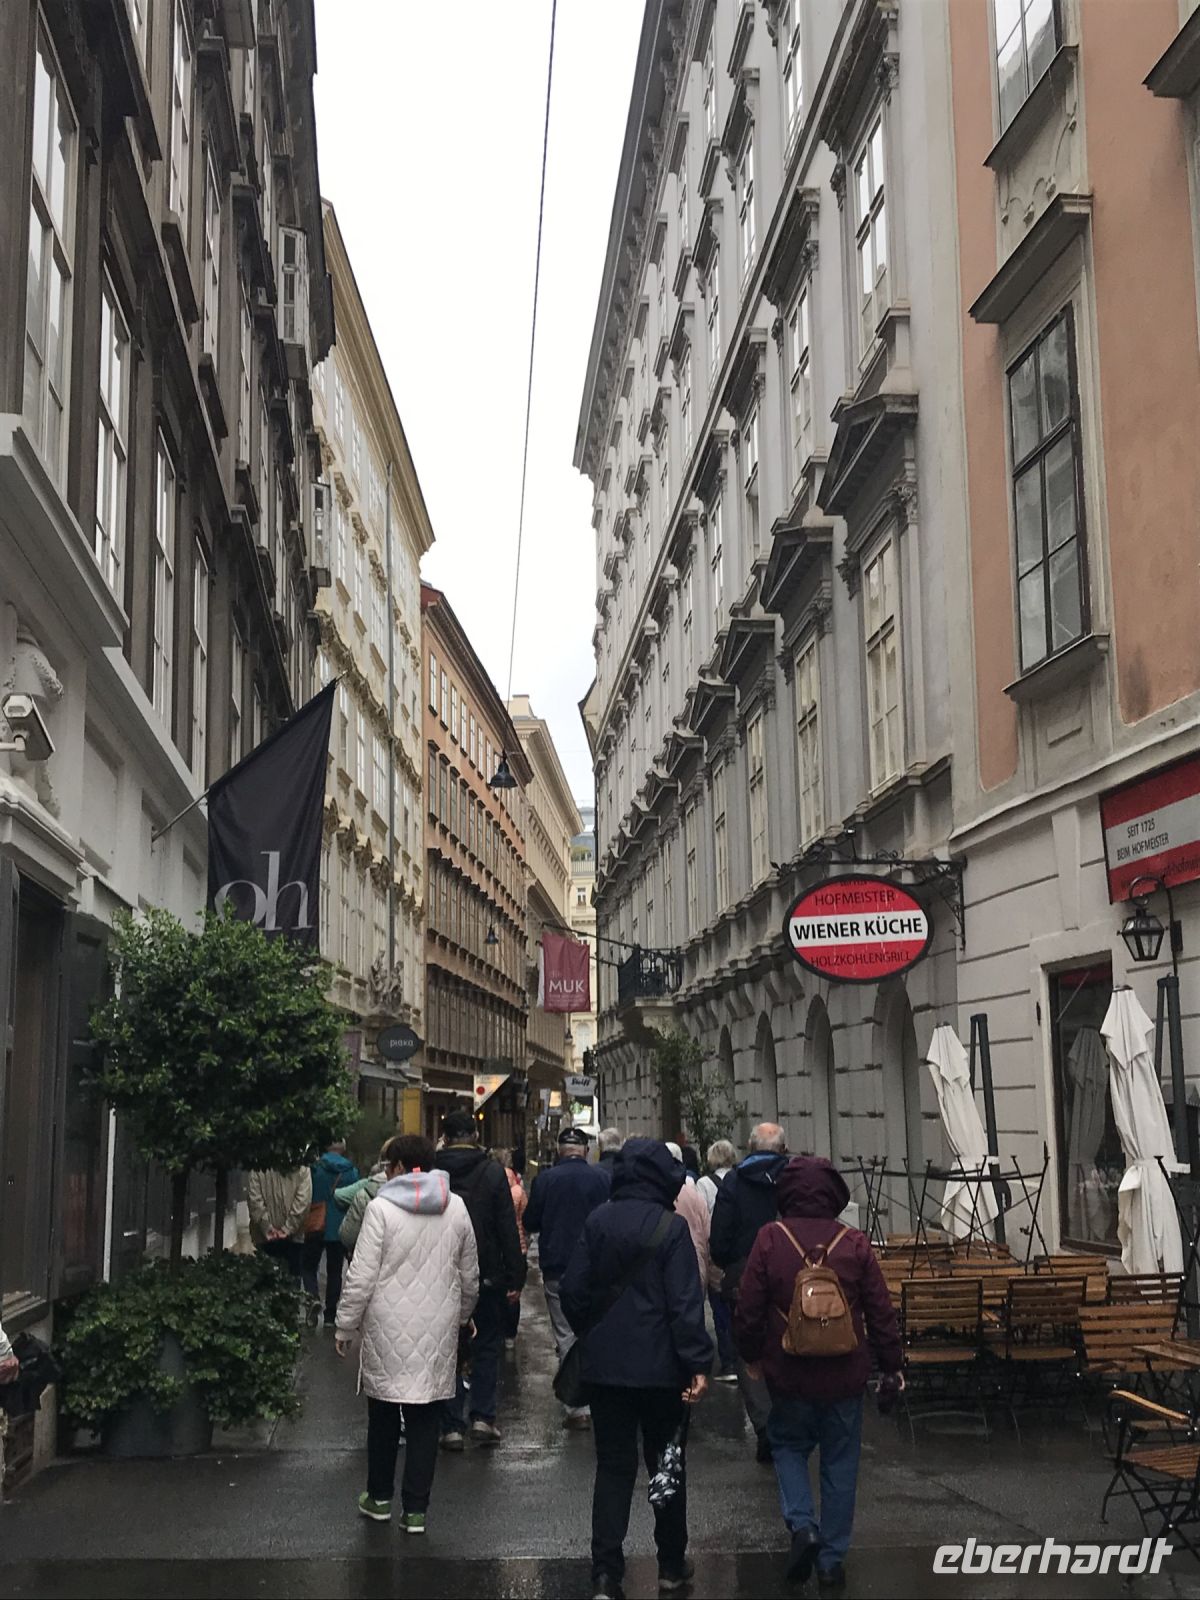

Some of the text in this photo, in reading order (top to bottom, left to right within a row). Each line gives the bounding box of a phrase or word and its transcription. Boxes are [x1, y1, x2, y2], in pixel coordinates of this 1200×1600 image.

[1127, 818, 1156, 839] SEIT 1725
[1117, 832, 1169, 861] BEIM HOFMEISTER
[814, 889, 895, 906] HOFMEISTER
[794, 915, 923, 940] WIENER KÜCHE
[810, 952, 911, 967] HOLZKOHLENGRILL
[549, 979, 585, 993] MUK
